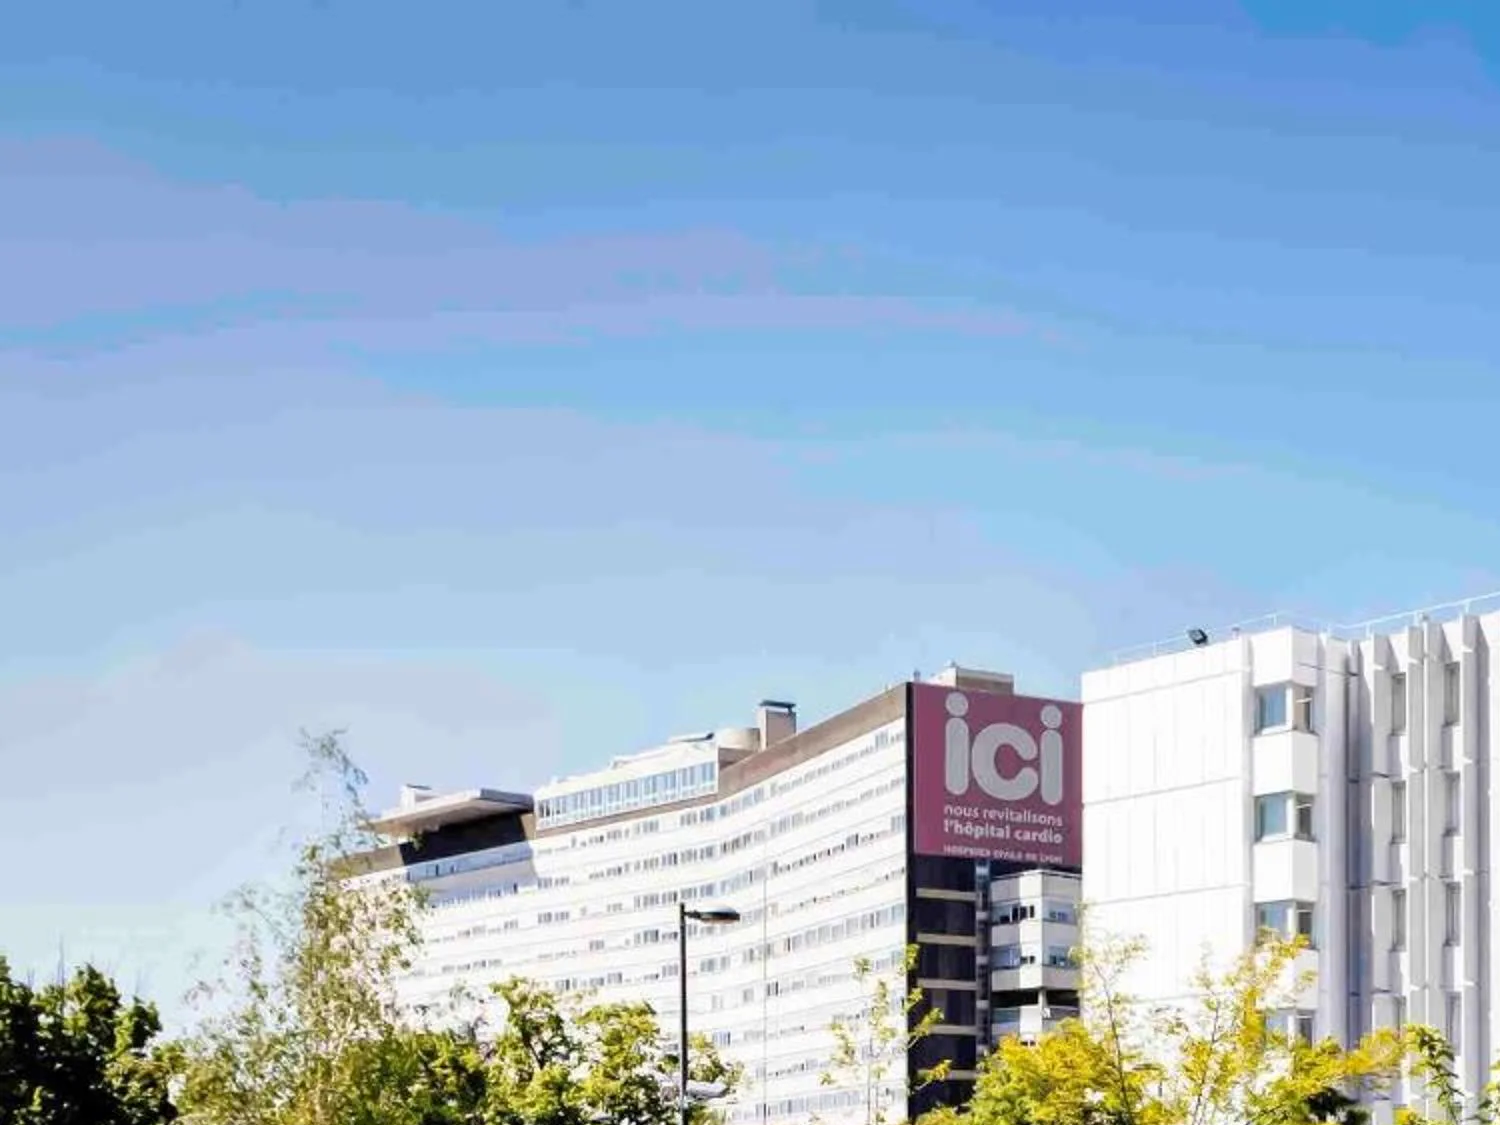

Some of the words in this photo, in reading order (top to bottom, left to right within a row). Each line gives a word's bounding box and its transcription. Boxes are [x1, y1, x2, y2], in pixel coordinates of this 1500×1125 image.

[945, 692, 1063, 806] ici
[943, 805, 979, 819] nous
[983, 807, 1063, 827] revitalisons
[943, 818, 1011, 839] l'hôpital
[1014, 827, 1063, 844] cardio
